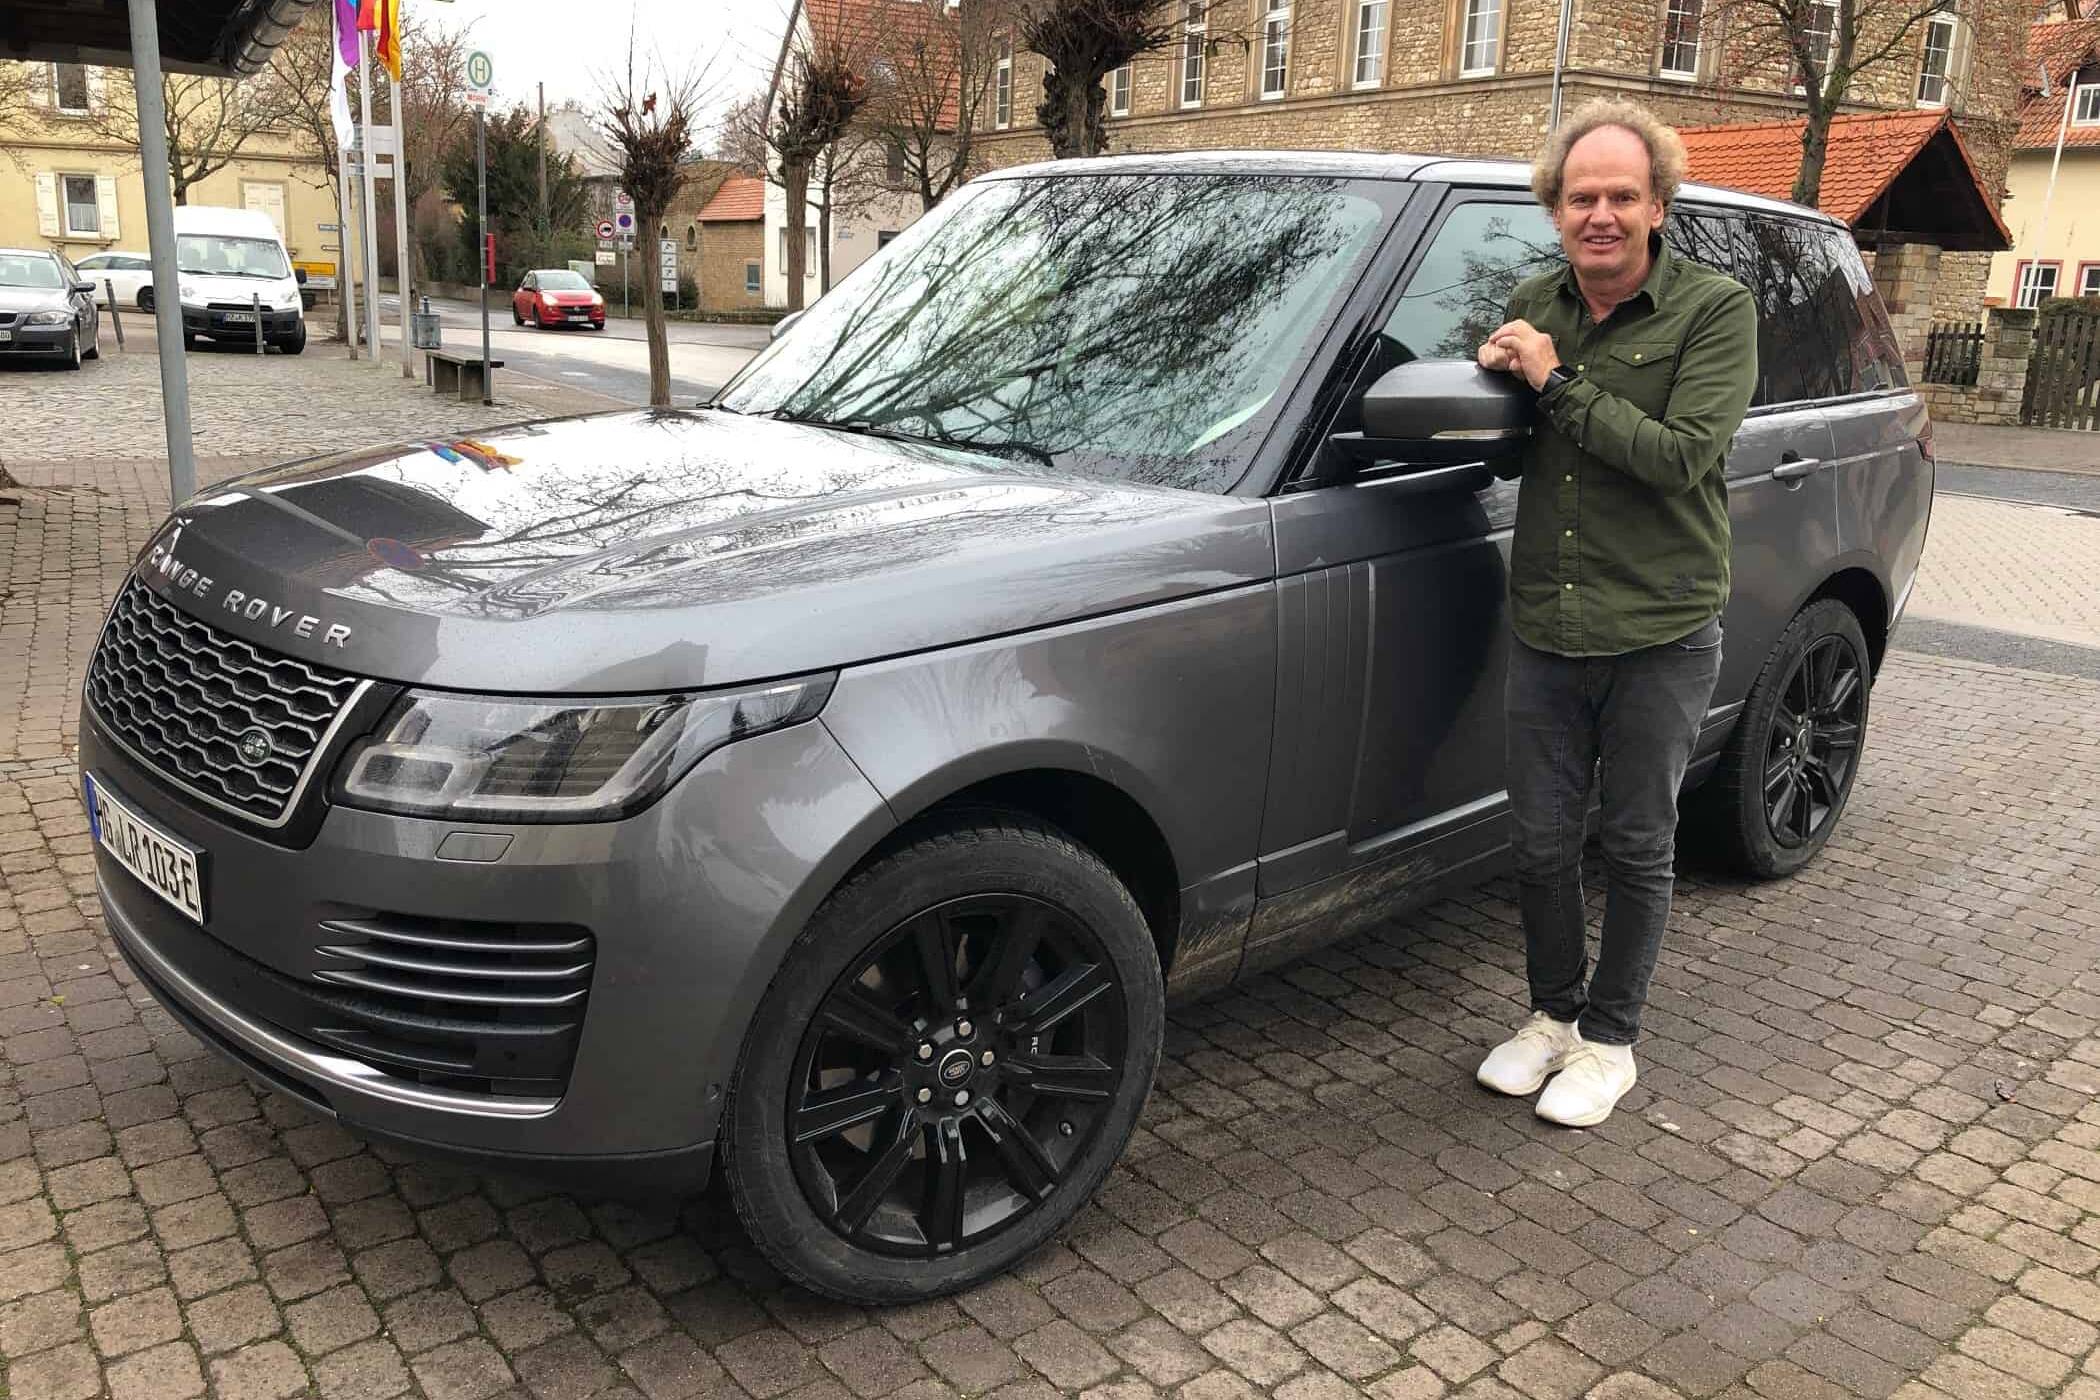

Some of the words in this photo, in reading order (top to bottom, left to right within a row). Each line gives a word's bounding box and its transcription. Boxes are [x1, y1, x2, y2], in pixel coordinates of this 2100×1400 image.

[474, 58, 486, 81] H
[150, 544, 214, 598] RANGE
[222, 589, 352, 649] ROVER
